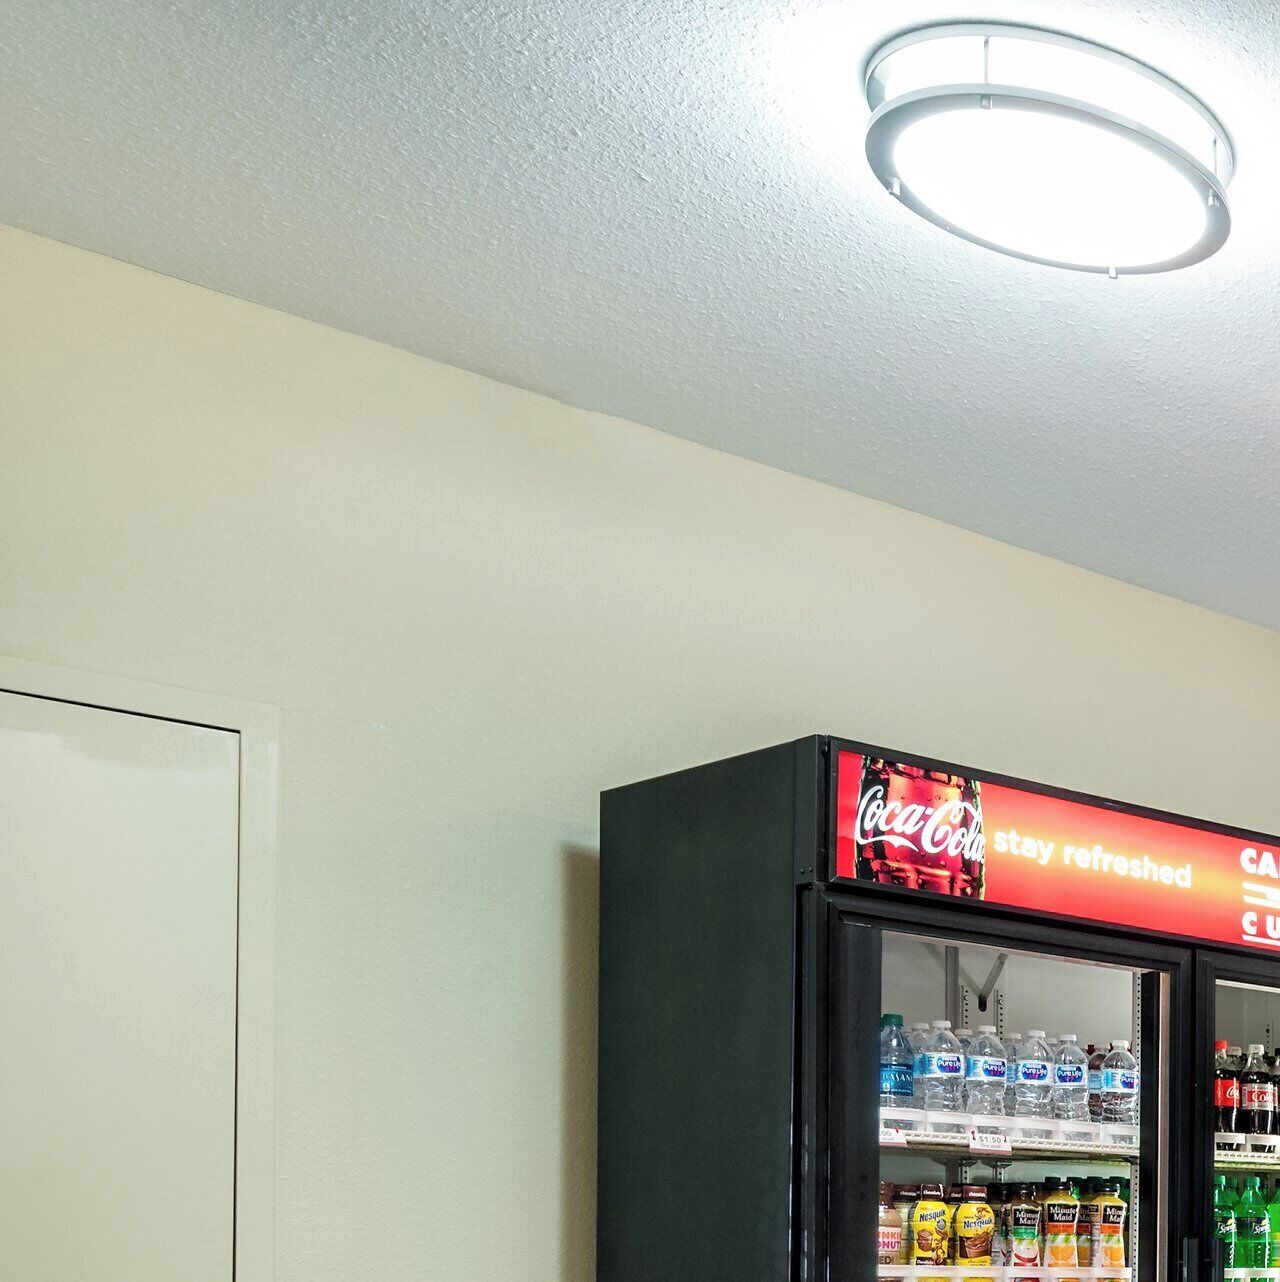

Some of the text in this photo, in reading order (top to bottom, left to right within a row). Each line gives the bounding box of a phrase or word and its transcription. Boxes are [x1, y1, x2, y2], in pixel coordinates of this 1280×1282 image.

[993, 828, 1193, 890] stay refreshed
[1037, 1068, 1047, 1076] Life
[920, 1209, 945, 1222] Nesquik
[964, 1218, 992, 1229] Nesquik
